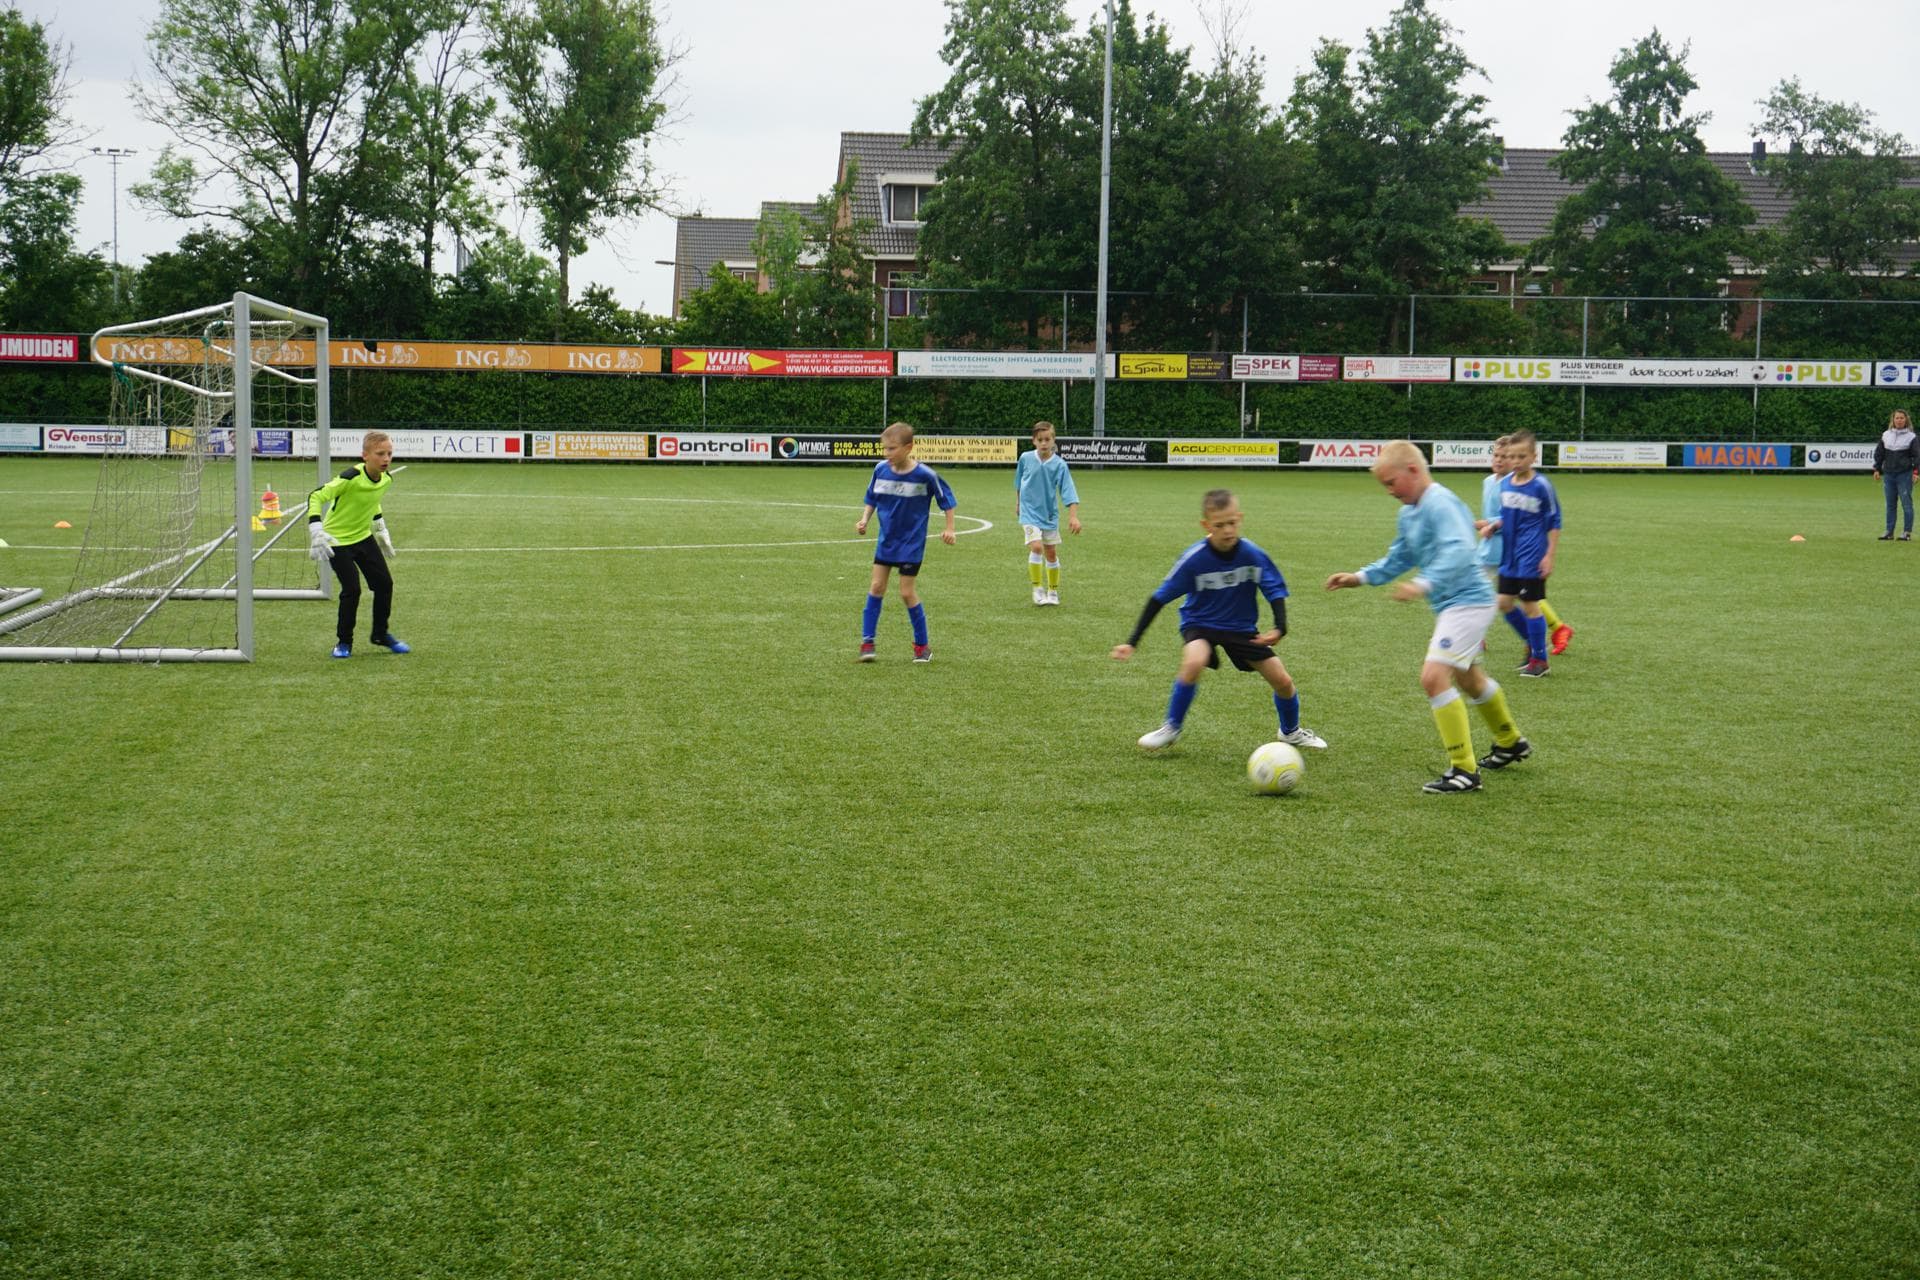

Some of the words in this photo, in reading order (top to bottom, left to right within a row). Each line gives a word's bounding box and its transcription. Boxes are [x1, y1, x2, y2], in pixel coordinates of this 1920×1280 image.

[341, 347, 387, 364] ING
[455, 350, 499, 366] ING
[568, 351, 611, 369] ING
[708, 352, 750, 365] VUIK
[786, 365, 890, 373] WWW.VUIK-EXPEDITIE.NL
[1252, 358, 1292, 369] SPEK
[1585, 362, 1624, 370] VERGEER
[901, 366, 920, 374] B&T
[1485, 361, 1551, 379] PLUS
[1629, 367, 1655, 377] daar
[1657, 368, 1695, 378] scoort
[1797, 365, 1863, 382] PLUS
[301, 434, 359, 443] Accntants
[433, 436, 499, 453] FACET
[660, 437, 769, 455] Controlin
[1172, 445, 1267, 453] ACCUCENTRALE
[1436, 445, 1446, 455] P.
[1450, 445, 1484, 455] Visser
[1695, 447, 1778, 466] MAGNA
[1825, 450, 1837, 459] de
